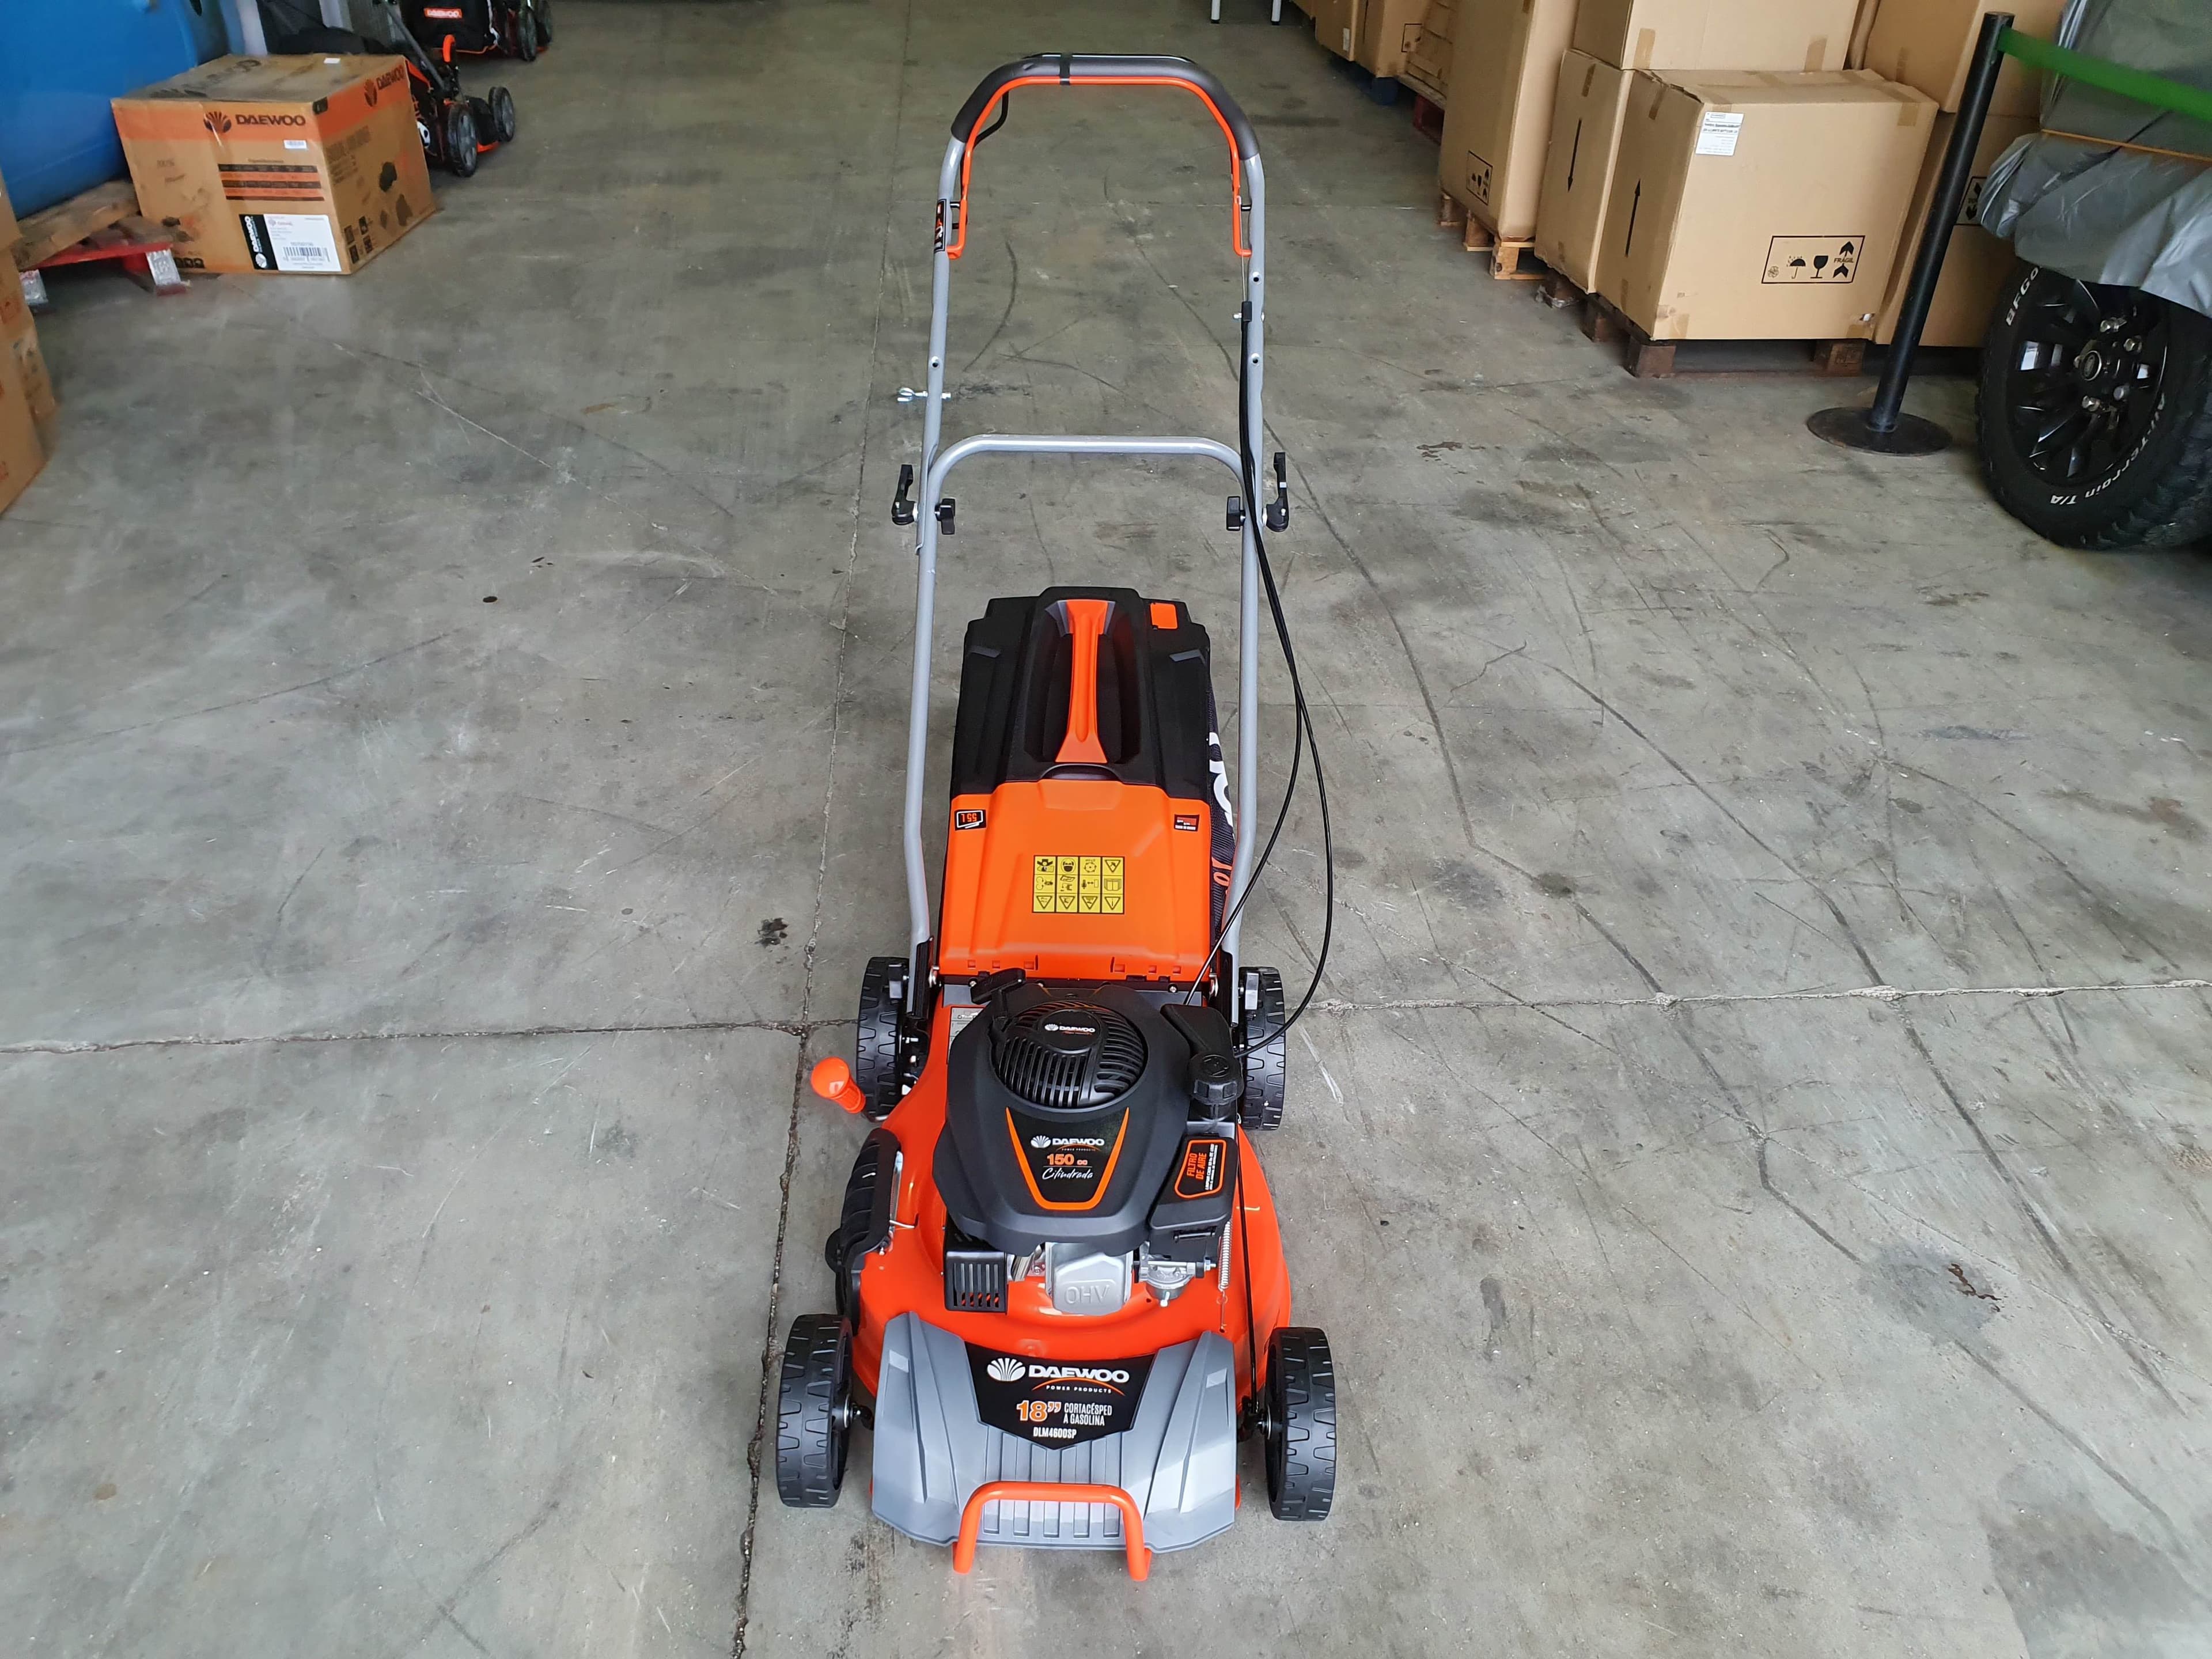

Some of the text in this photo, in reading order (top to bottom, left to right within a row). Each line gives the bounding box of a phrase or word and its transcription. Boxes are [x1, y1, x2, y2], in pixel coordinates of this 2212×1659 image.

[376, 65, 405, 90] DAEWOO
[235, 114, 306, 126] DAEWOO
[244, 216, 259, 252] DAEWOO
[2050, 495, 2078, 505] T/A
[967, 813, 977, 823] 55
[1052, 1138, 1105, 1146] DAEWOO
[1047, 1153, 1075, 1165] 150
[1187, 1153, 1198, 1177] FILTRO
[1195, 1152, 1207, 1180] DE AIRE
[1042, 1168, 1093, 1180] Cilindrada
[1064, 1285, 1111, 1304] OHV
[1028, 1365, 1130, 1383] DAEWOO
[1064, 1403, 1112, 1416] CORTACÉSPED
[1063, 1413, 1105, 1426] A GASOLINA
[1033, 1427, 1077, 1438] DLM4600SP
